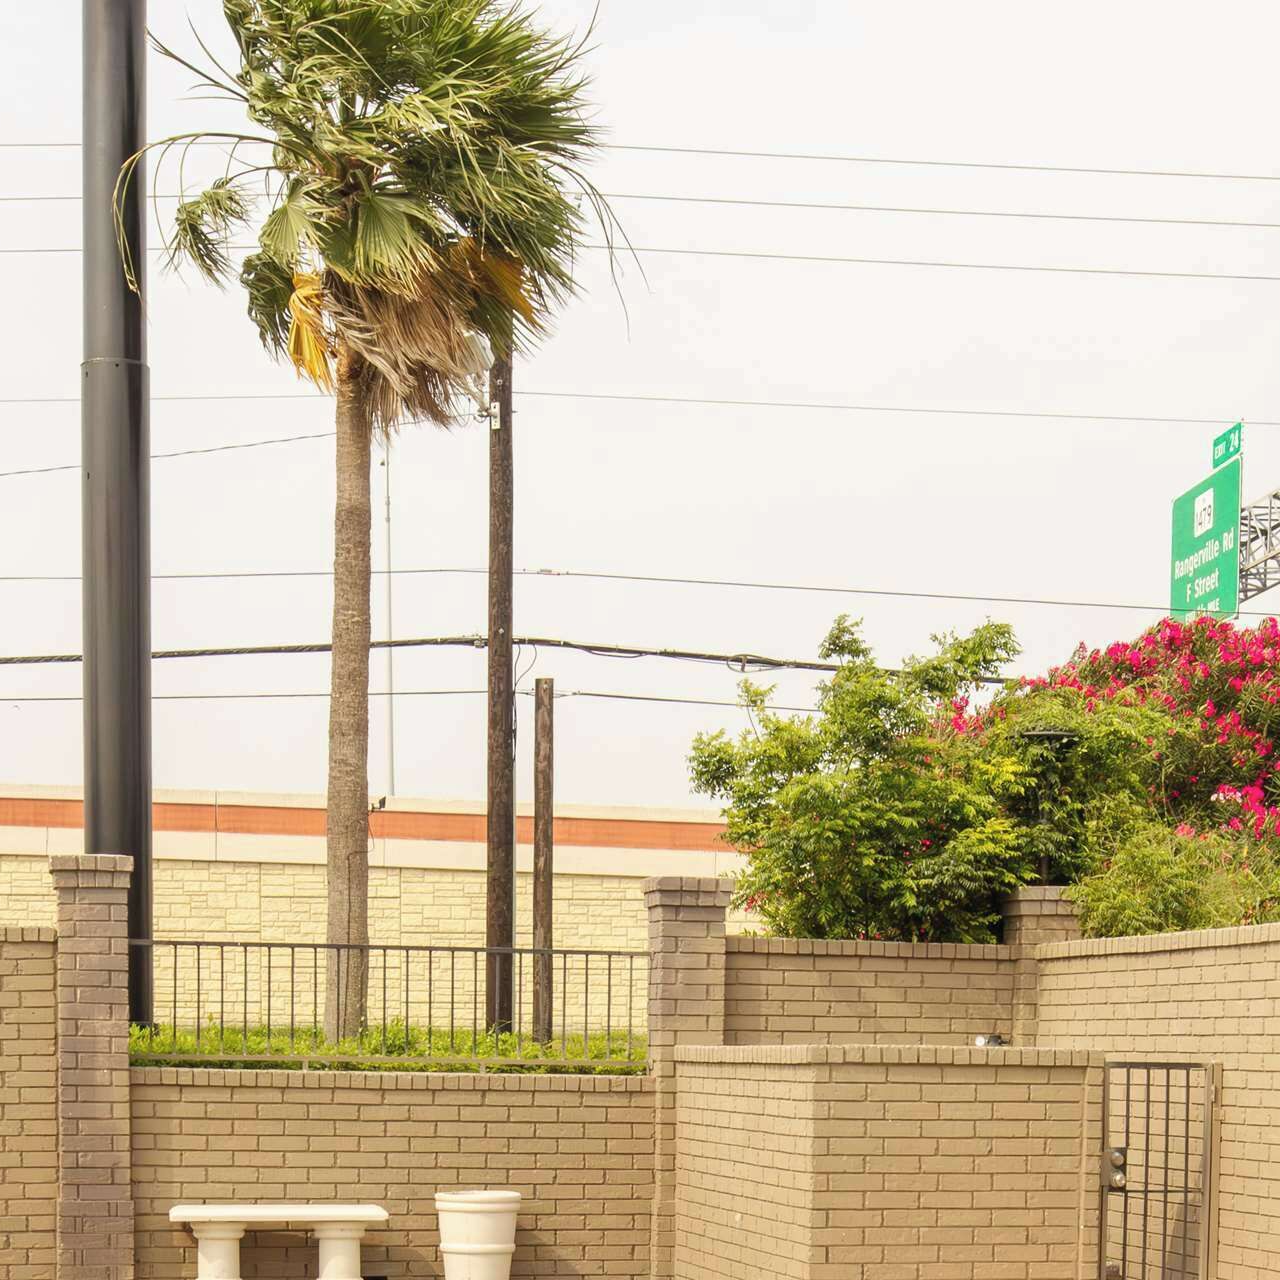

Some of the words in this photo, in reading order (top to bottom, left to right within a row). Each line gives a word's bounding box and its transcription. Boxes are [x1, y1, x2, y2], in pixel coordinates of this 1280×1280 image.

[1228, 430, 1239, 452] 24
[1174, 539, 1220, 580] Rangerville
[1223, 527, 1234, 553] Rd
[1186, 583, 1192, 603] F
[1194, 567, 1220, 599] Street
